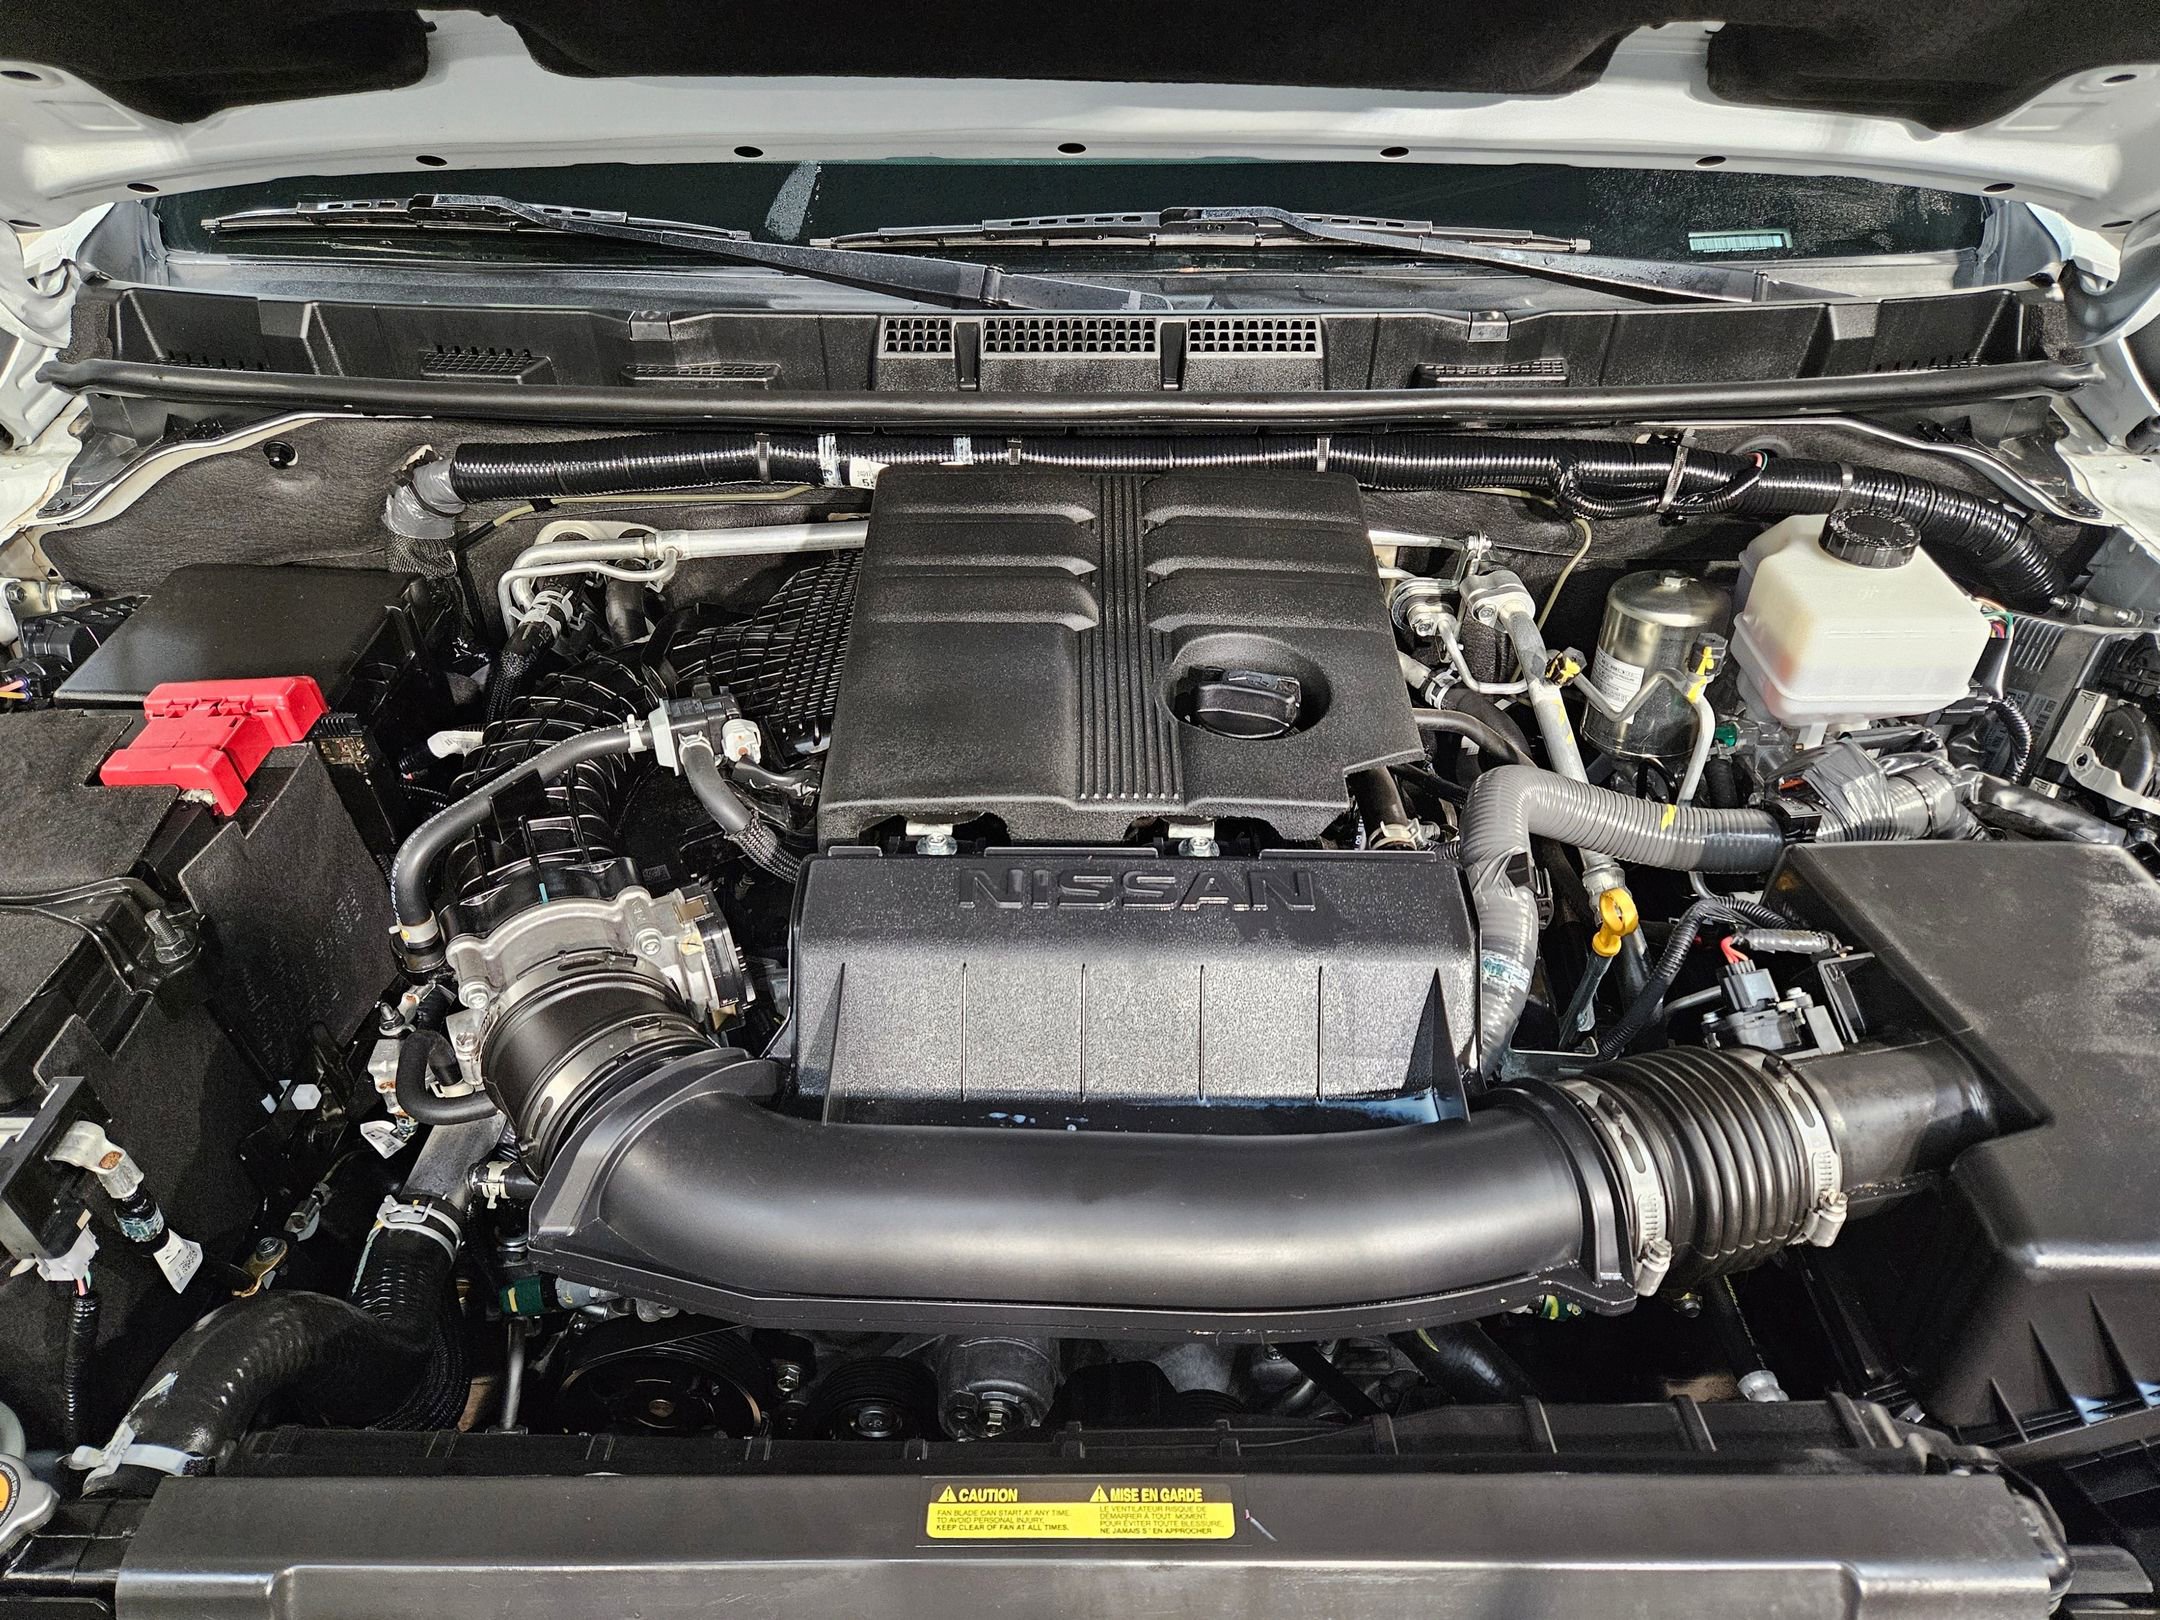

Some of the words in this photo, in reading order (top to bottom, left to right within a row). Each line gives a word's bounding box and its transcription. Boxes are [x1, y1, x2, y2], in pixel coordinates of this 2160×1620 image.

[958, 868, 1316, 911] NISSAN
[958, 1488, 1018, 1502] CAUTION
[1110, 1487, 1140, 1502] MISE
[1141, 1487, 1159, 1502] EN
[1159, 1487, 1203, 1502] GARDE
